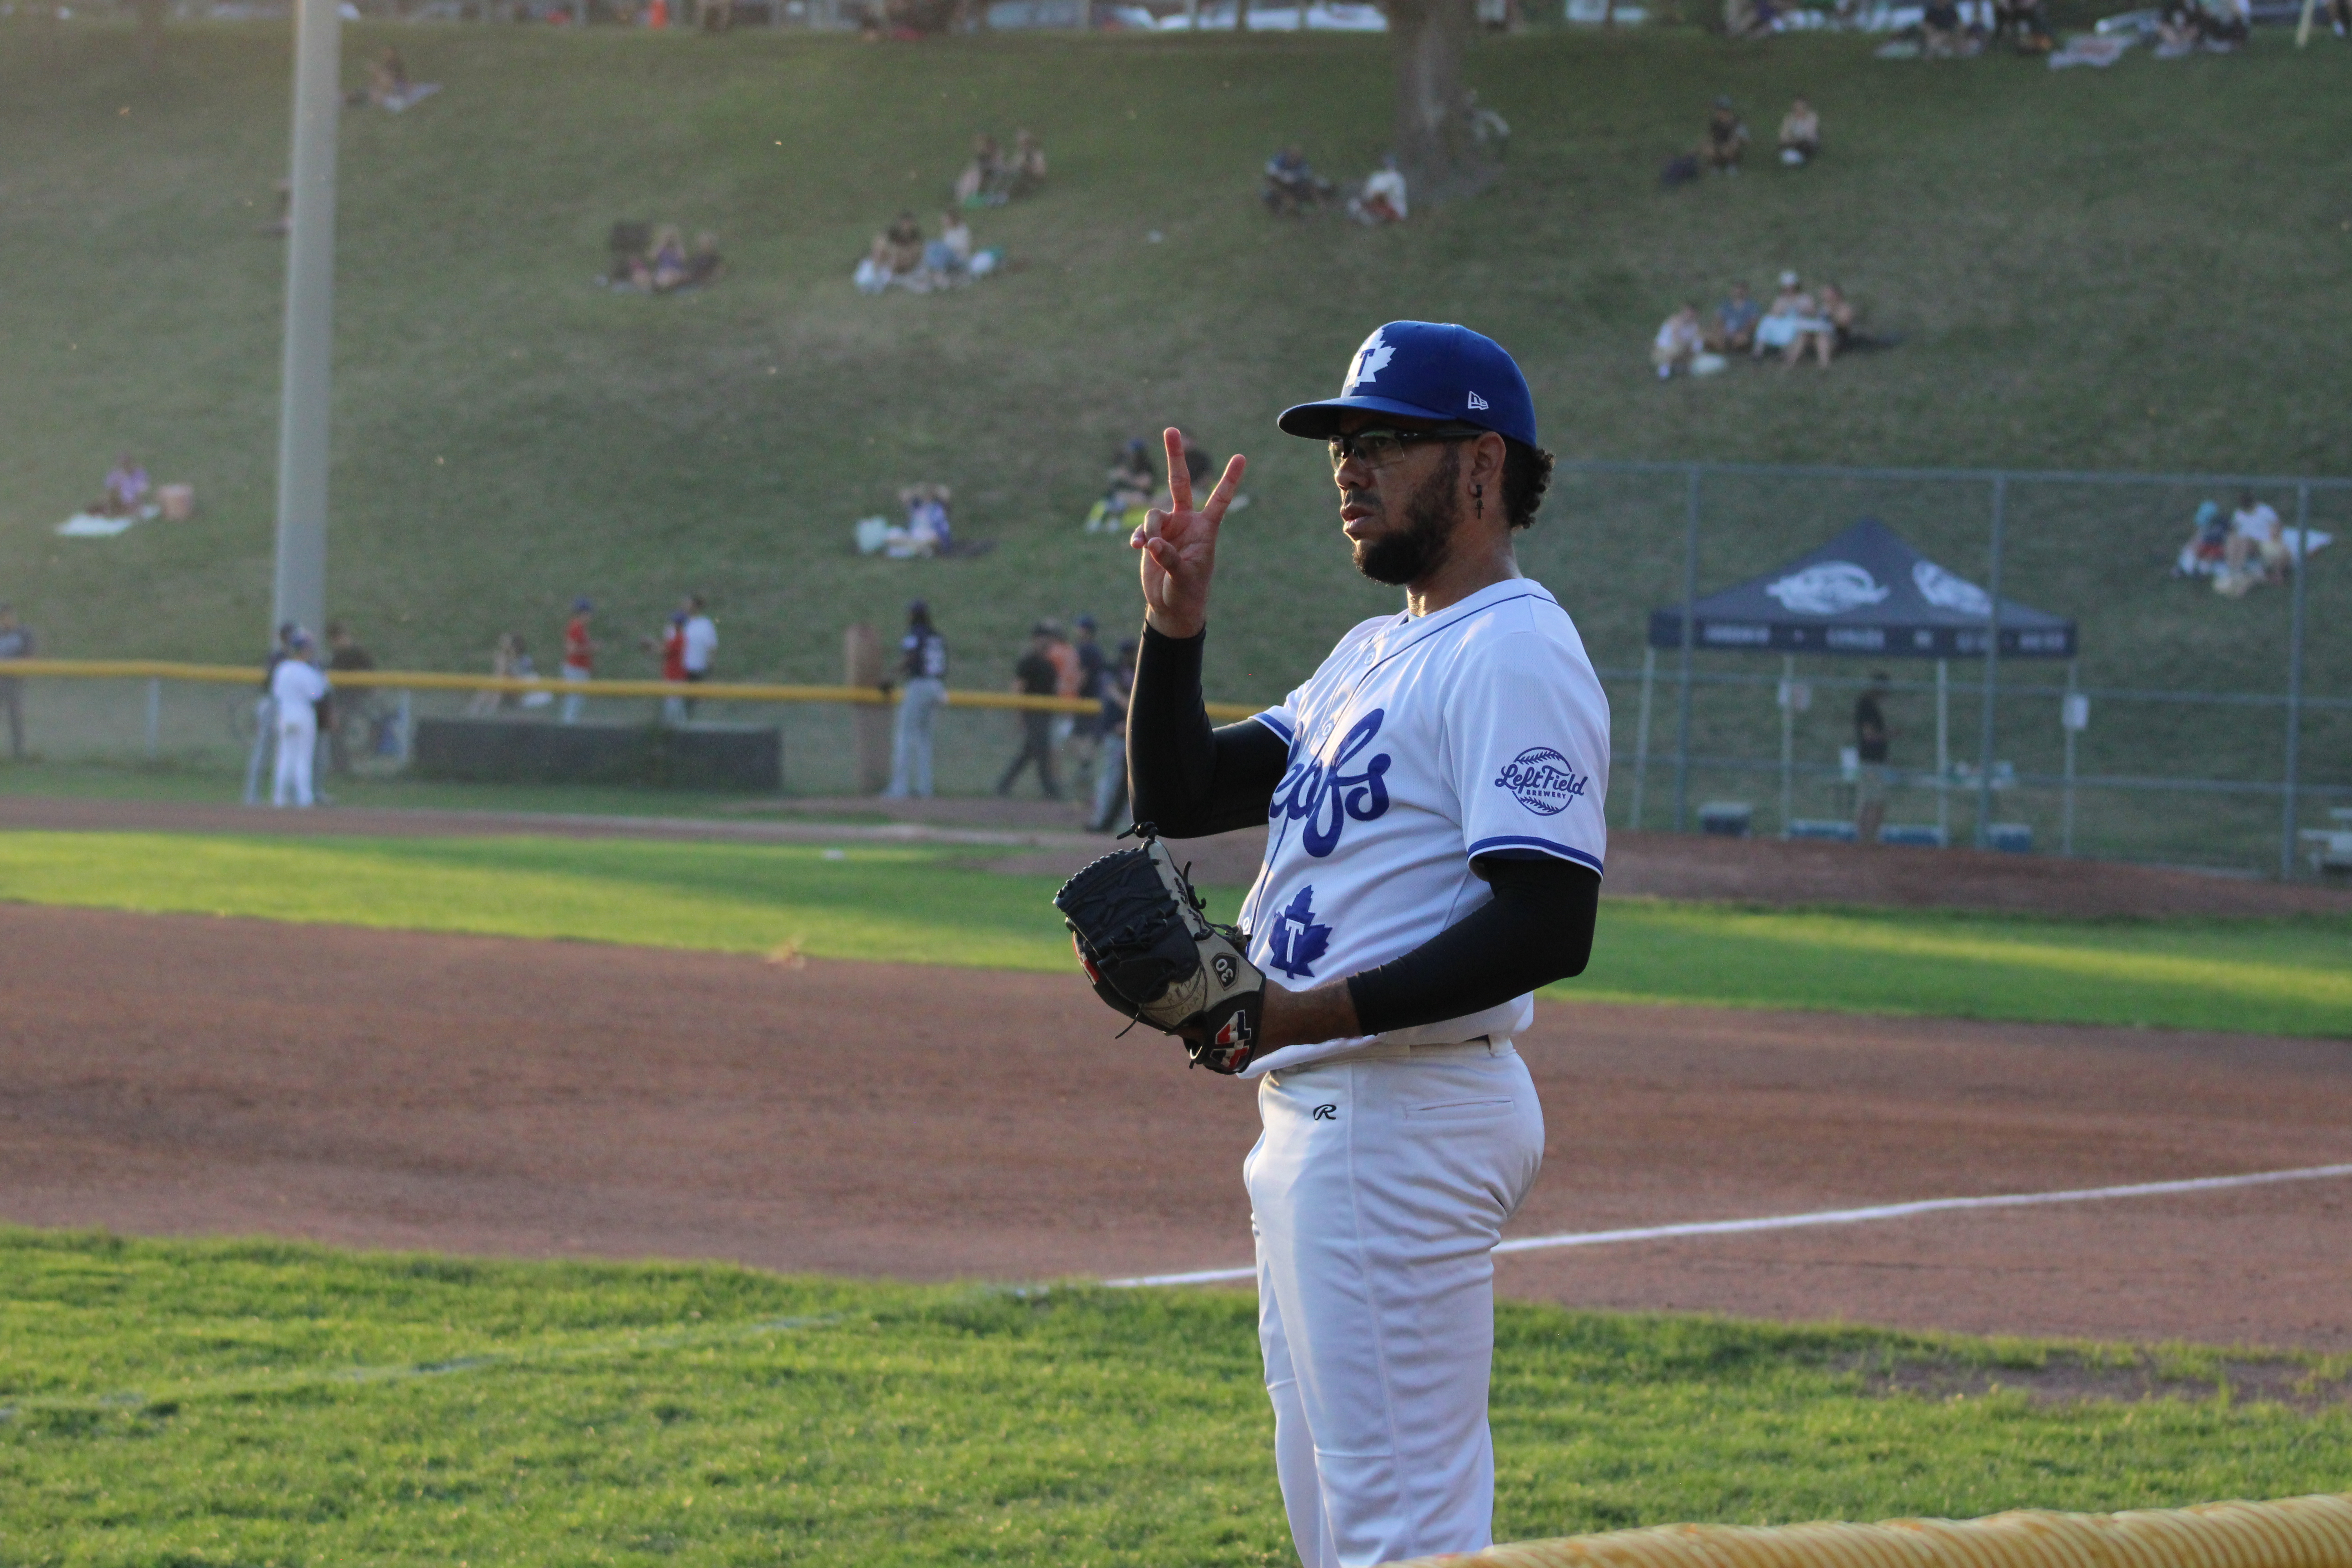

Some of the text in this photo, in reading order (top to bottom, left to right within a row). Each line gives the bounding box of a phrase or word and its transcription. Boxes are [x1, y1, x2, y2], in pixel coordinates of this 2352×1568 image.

[1357, 348, 1376, 376] T
[1494, 764, 1588, 796] Left Field
[1526, 789, 1566, 799] BREWERY
[1285, 918, 1305, 964] T
[1216, 958, 1234, 982] 30
[1313, 1104, 1337, 1120] R
